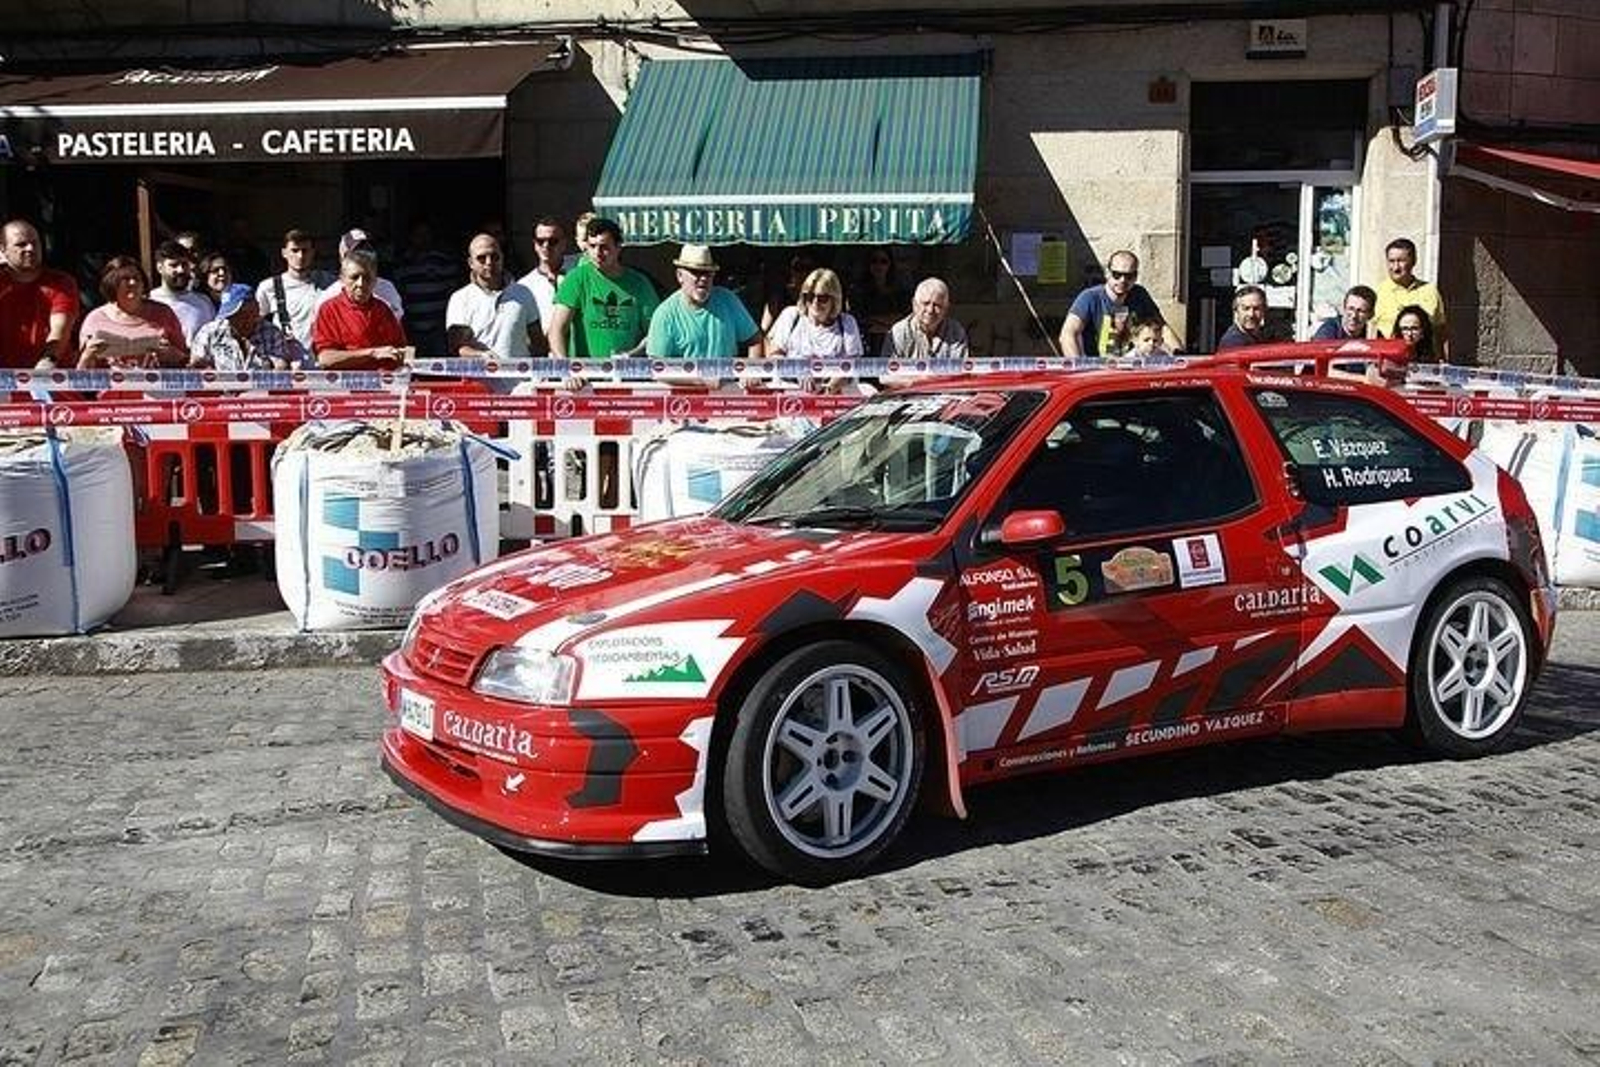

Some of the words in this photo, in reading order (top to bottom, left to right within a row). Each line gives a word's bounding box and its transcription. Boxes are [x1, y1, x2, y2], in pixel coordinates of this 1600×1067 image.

[57, 131, 216, 157] PASTELERIA
[261, 127, 416, 154] CAFETERIA
[618, 209, 787, 237] MERCERIA
[818, 207, 947, 235] PEPITA
[1323, 467, 1342, 489] H.
[1383, 494, 1487, 558] coarvi
[343, 533, 460, 571] COELLO
[1054, 554, 1088, 605] 5
[1125, 722, 1200, 747] SECUNDINO
[1205, 711, 1265, 732] VAZQUEZ
